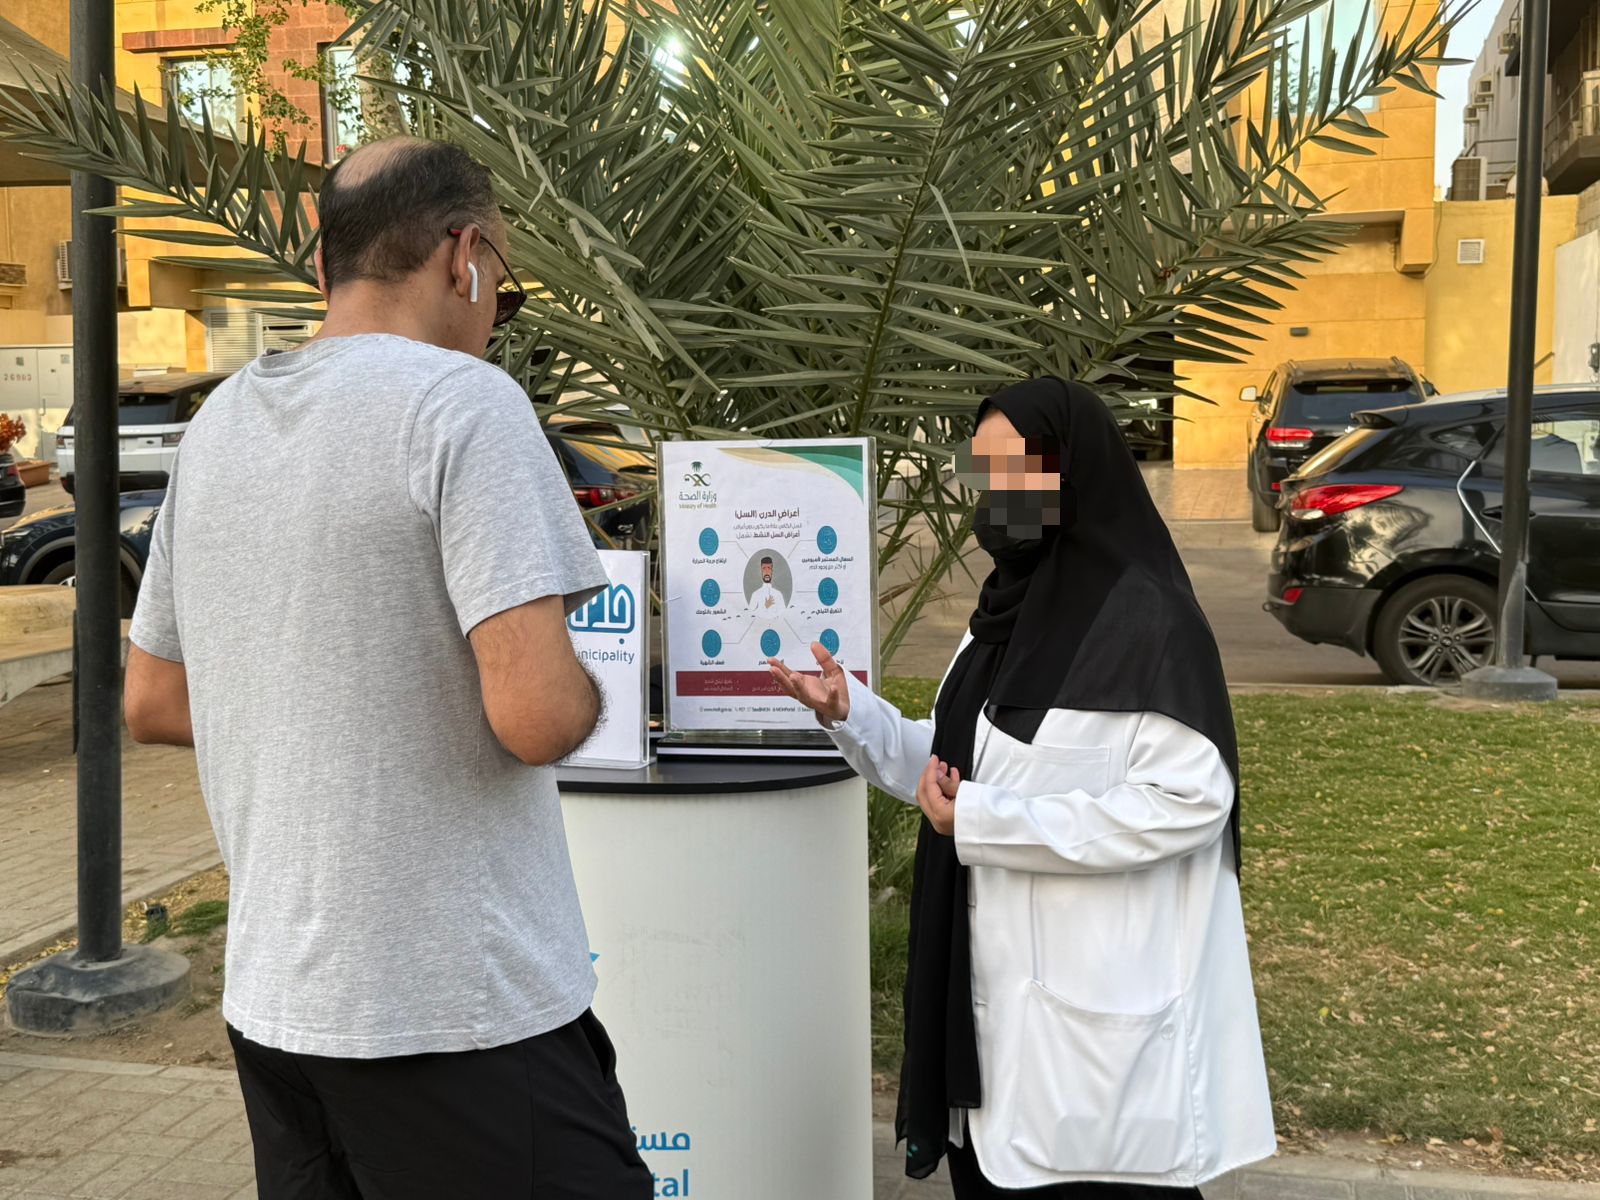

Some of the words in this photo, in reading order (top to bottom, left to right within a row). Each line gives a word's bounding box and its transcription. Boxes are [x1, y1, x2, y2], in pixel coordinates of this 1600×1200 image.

[679, 490, 701, 501] الصحة
[702, 490, 717, 502] وزارة
[759, 509, 777, 520] الدرن
[777, 506, 800, 521] أعراض
[577, 649, 636, 665] nicipality
